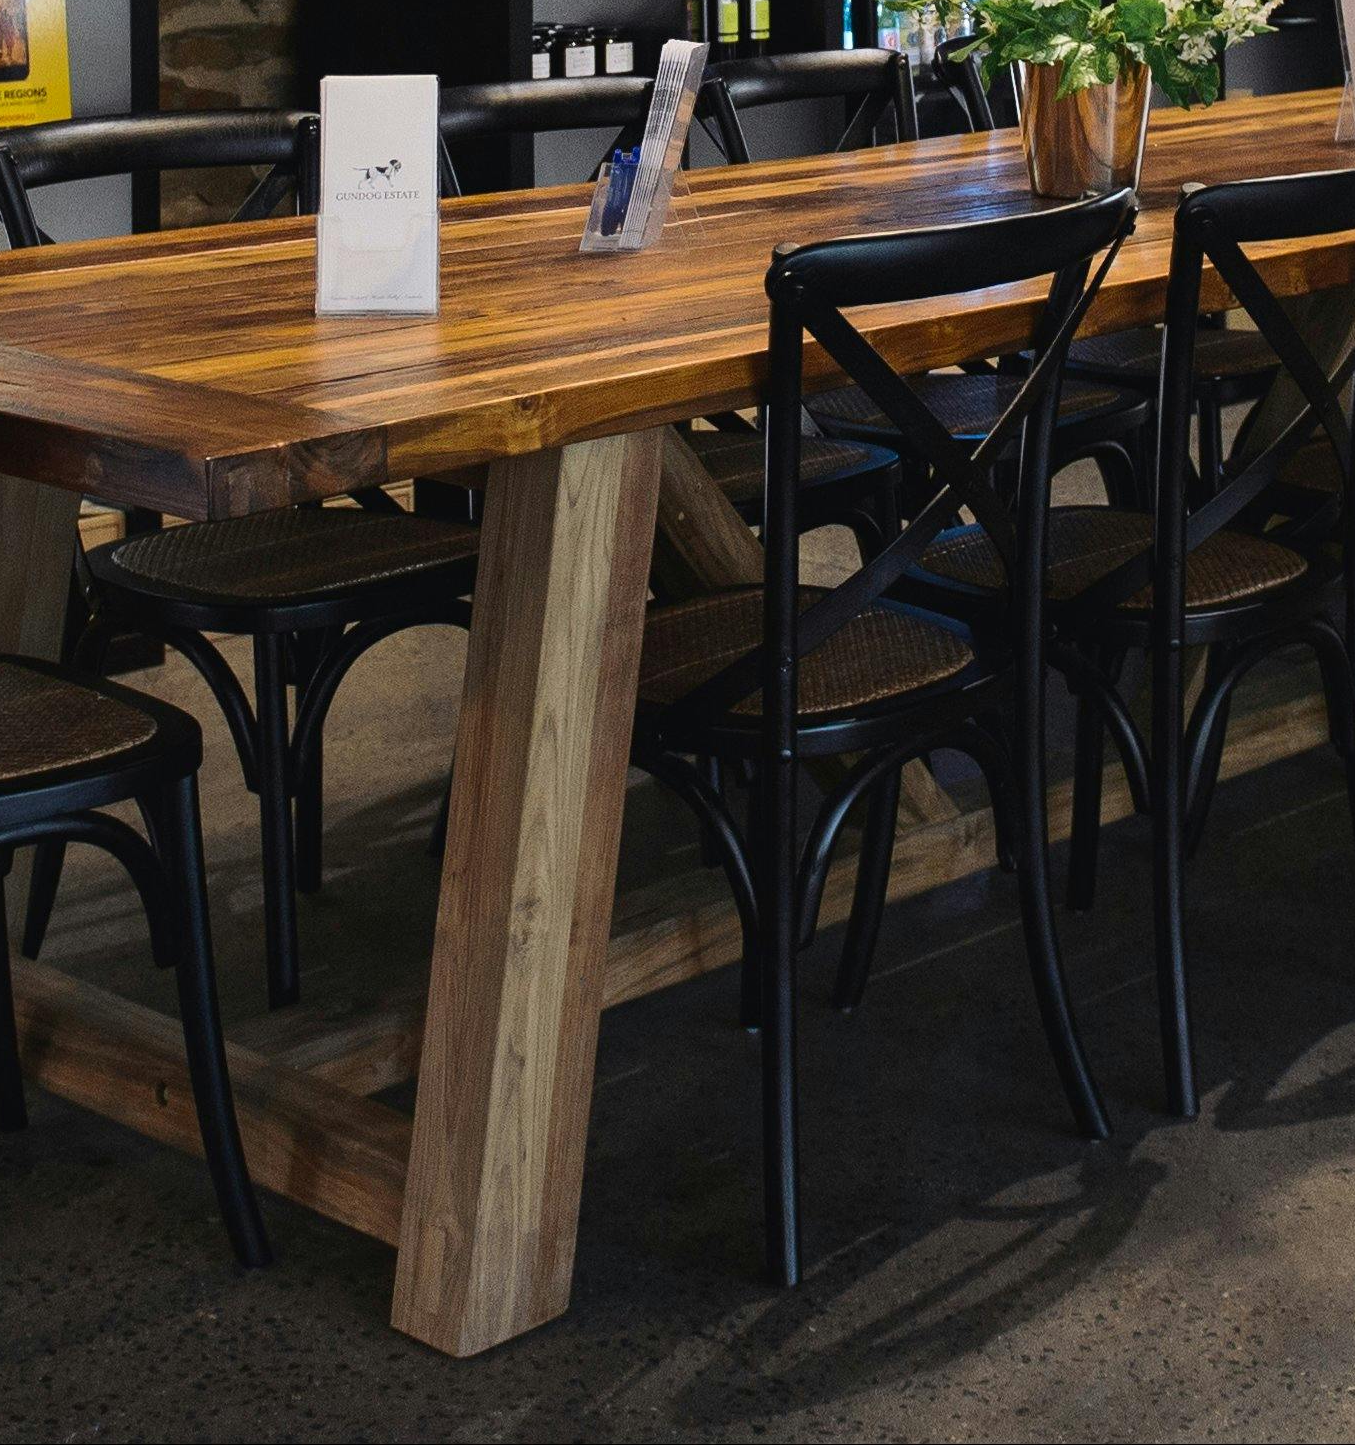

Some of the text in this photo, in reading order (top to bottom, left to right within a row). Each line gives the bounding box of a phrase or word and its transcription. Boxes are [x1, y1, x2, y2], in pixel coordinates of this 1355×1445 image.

[4, 88, 47, 99] REGIONS
[335, 190, 420, 201] GUNDOG ESTATE
